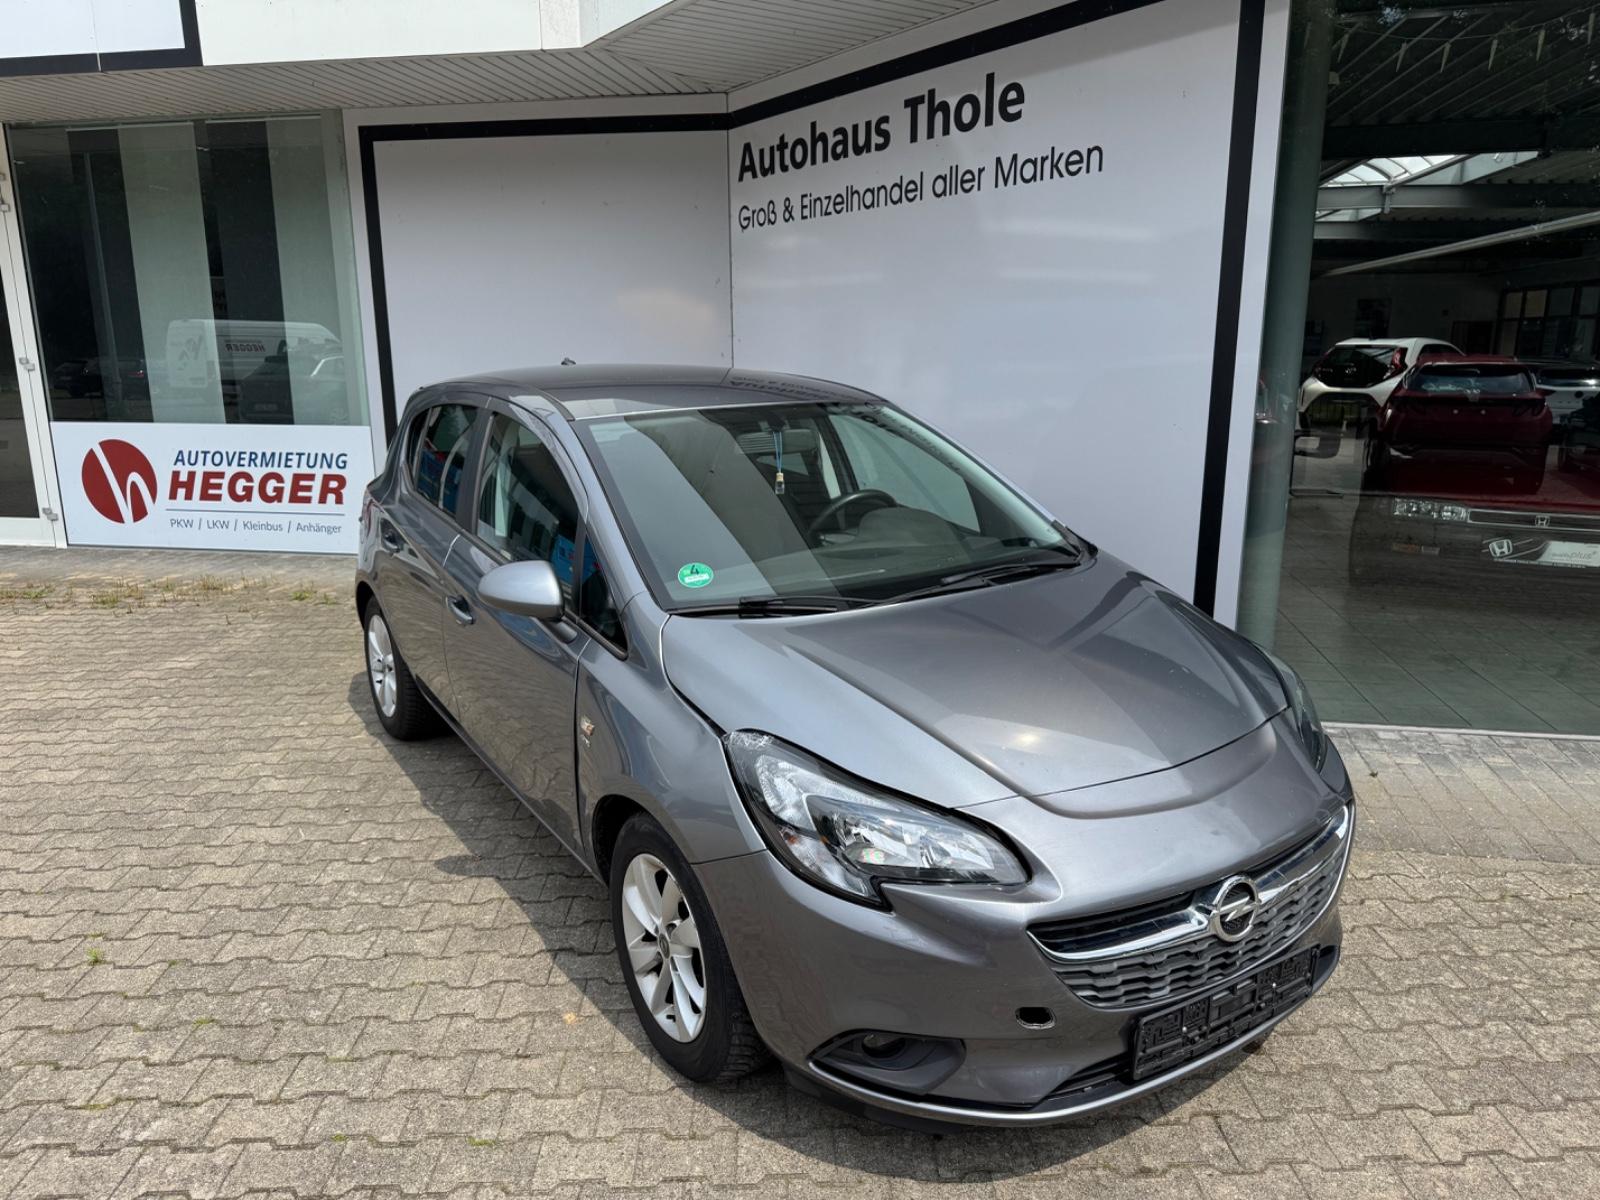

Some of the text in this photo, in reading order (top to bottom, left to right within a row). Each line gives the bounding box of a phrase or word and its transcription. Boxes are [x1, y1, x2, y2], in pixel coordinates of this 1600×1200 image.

[738, 72, 1025, 182] Autohaus Thole
[738, 145, 1103, 231] Groß & Einzelhandel aller Marken
[173, 449, 348, 470] AUTOVERMIETUNG
[168, 470, 347, 505] HEGGER
[169, 518, 194, 529] PKW
[206, 519, 230, 530] LKW
[242, 520, 283, 532] Kleinbus
[296, 522, 342, 534] Anhänger
